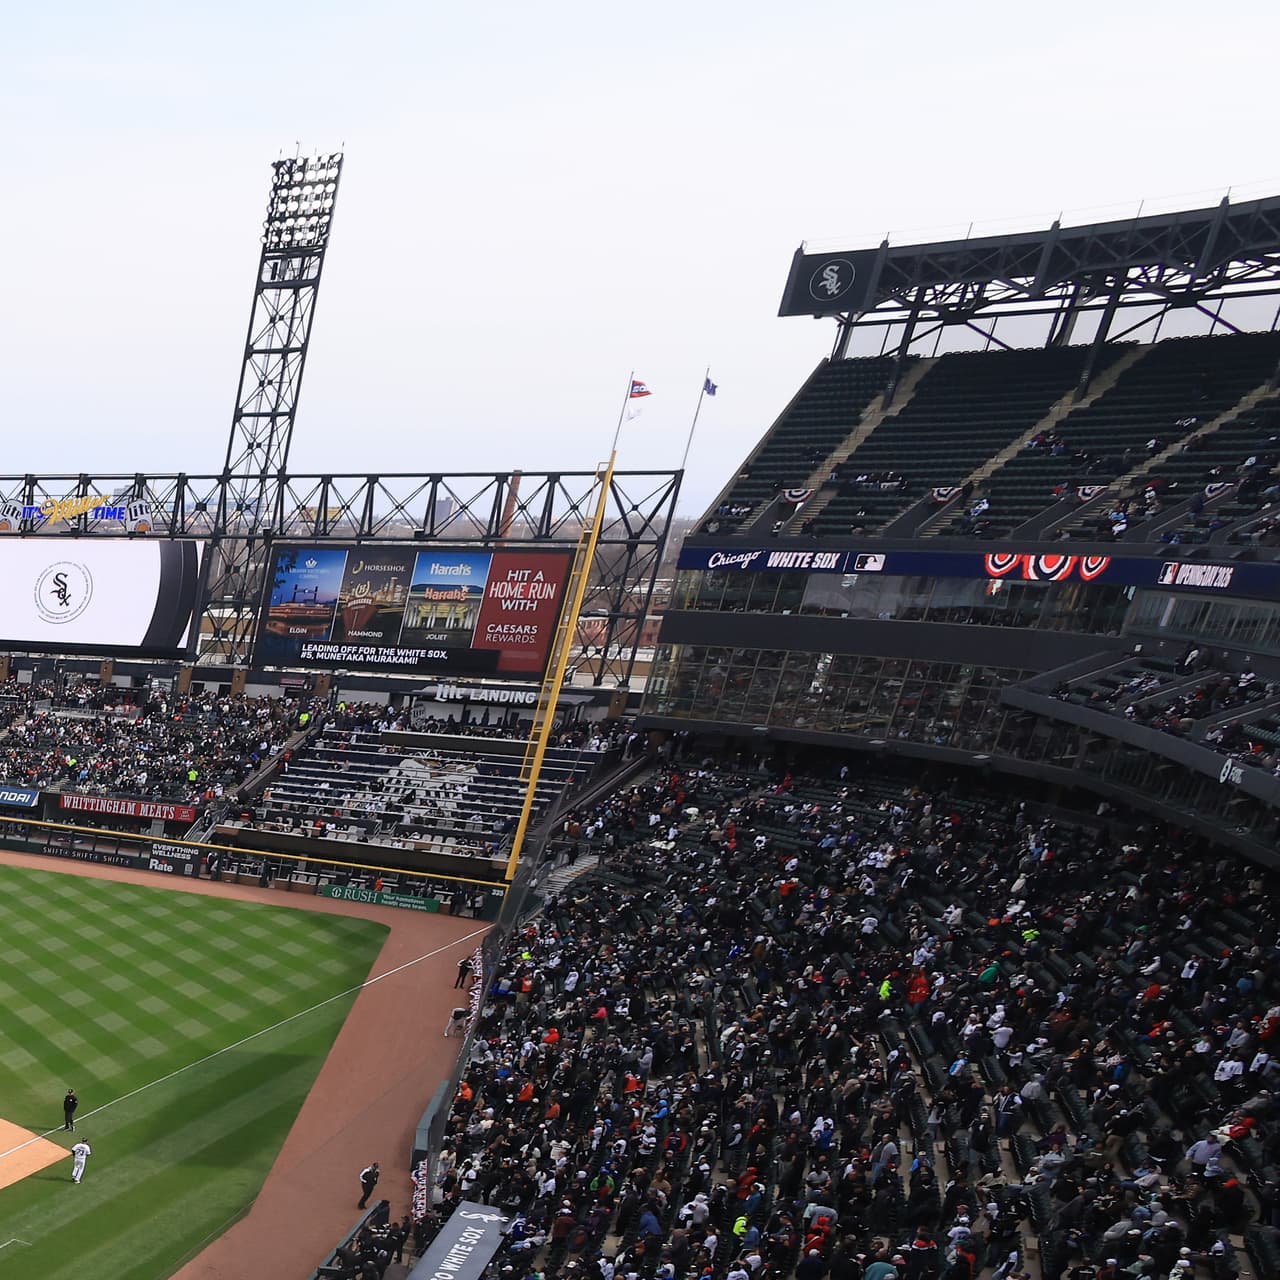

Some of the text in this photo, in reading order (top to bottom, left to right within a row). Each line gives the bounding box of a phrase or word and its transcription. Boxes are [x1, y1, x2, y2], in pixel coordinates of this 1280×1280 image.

[0, 502, 23, 519] Lite
[22, 495, 125, 525] IT'S Miller TIME
[128, 501, 151, 521] Lite
[708, 550, 840, 570] Chicago WHITE SOX
[430, 562, 472, 576] Harrah's
[508, 570, 544, 582] HIT A
[490, 581, 557, 600] HOME RUN
[501, 600, 537, 611] WITH
[348, 630, 383, 638] HAMMOND
[486, 624, 538, 635] CAESARS
[425, 633, 448, 641] JOLIET
[302, 644, 339, 653] LEADING
[340, 646, 358, 654] OFF
[358, 646, 376, 654] FOR
[378, 648, 396, 656] THE
[397, 649, 426, 658] WHITE
[316, 652, 364, 662] MUNETAKA
[434, 684, 536, 704] Lite LANDING
[64, 795, 135, 816] WHITTINGHAM
[140, 804, 176, 820] MEATS
[152, 844, 199, 856] EVERYTHING
[152, 850, 192, 860] WELLNESS
[149, 858, 174, 873] Rate
[344, 890, 378, 904] RUSH
[438, 1244, 473, 1272] WHITE
[458, 1226, 487, 1245] SOX
